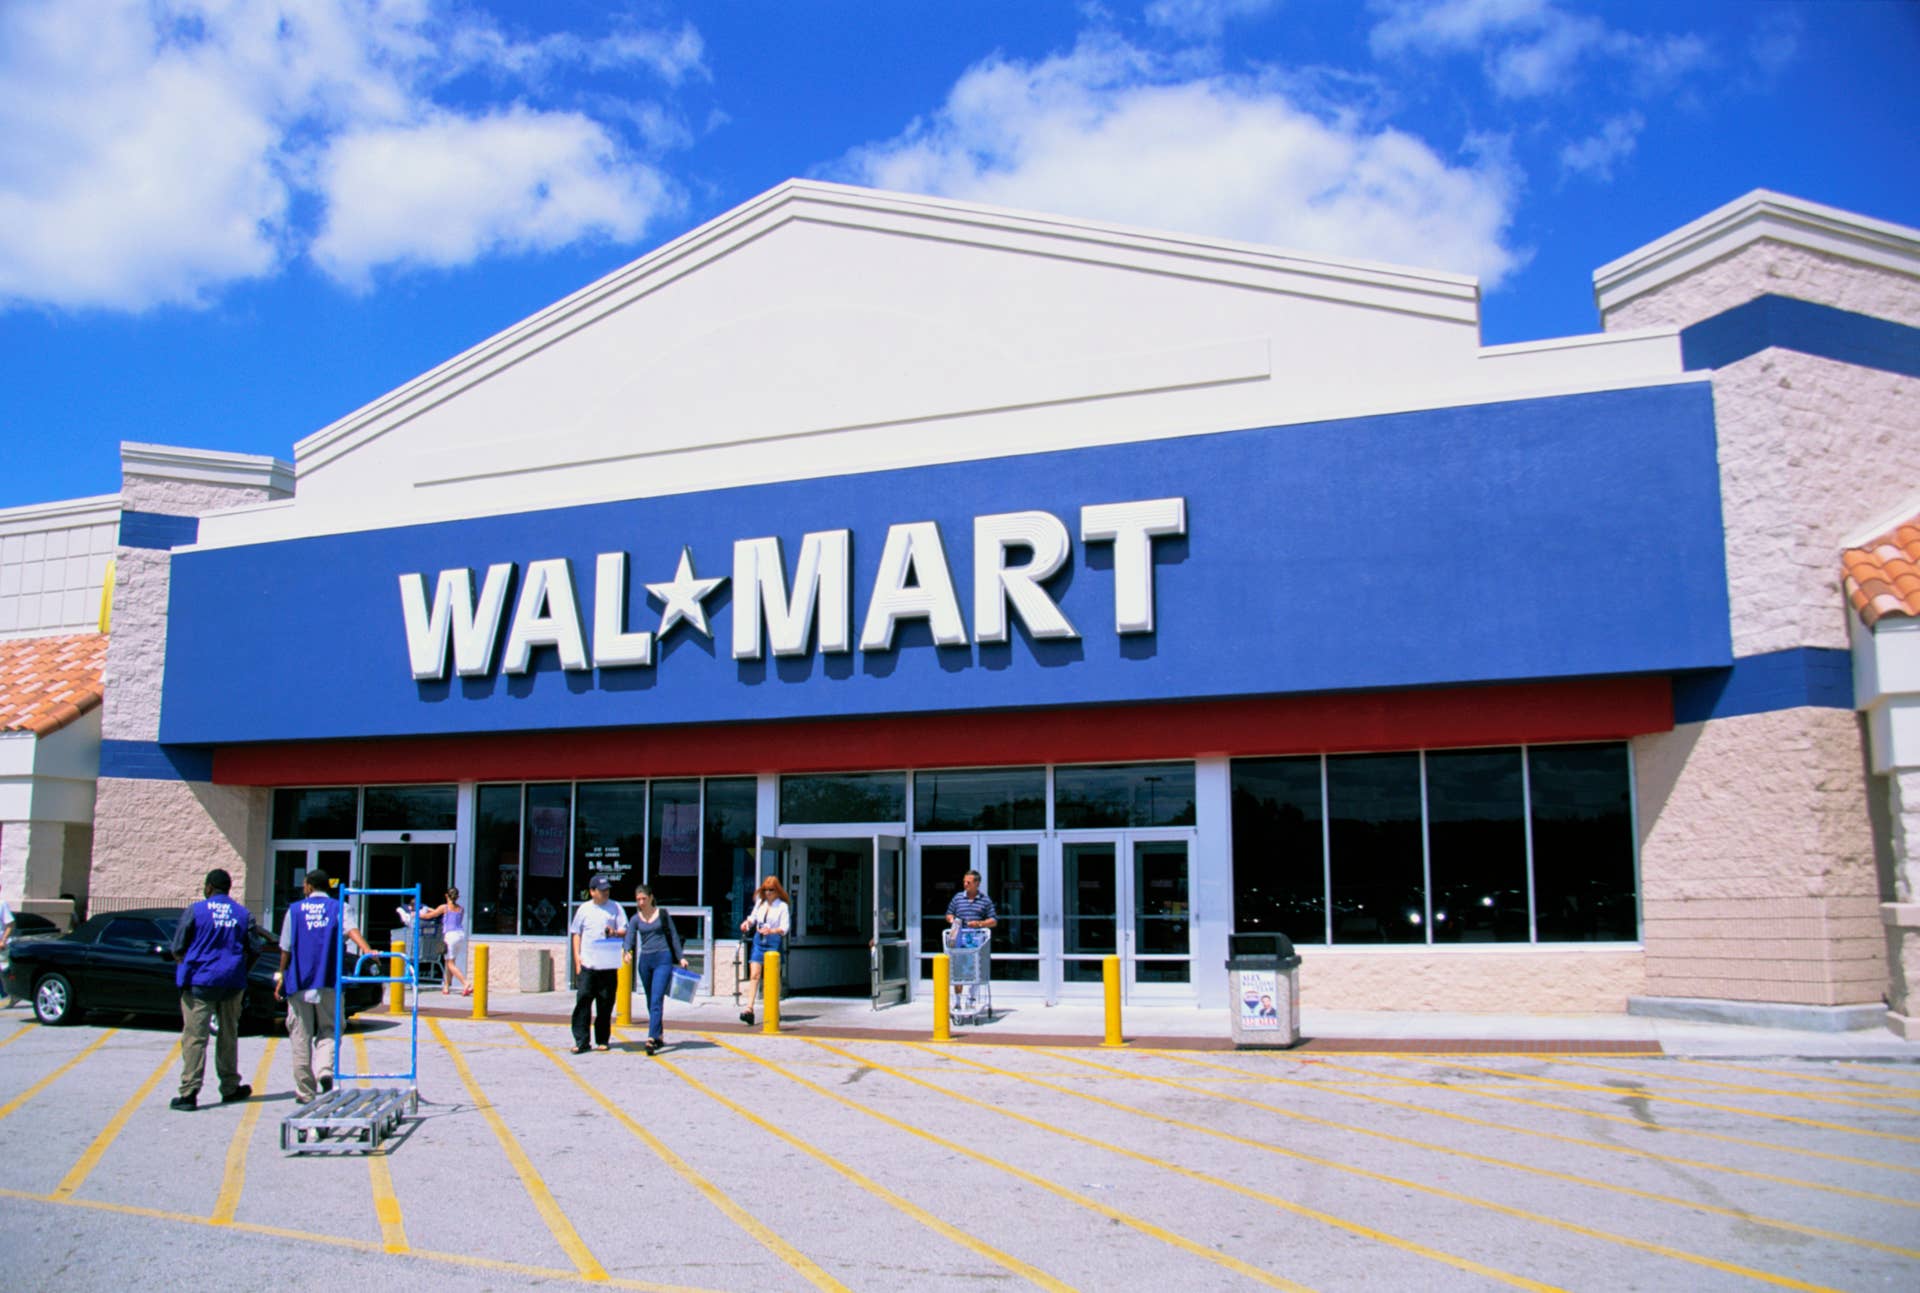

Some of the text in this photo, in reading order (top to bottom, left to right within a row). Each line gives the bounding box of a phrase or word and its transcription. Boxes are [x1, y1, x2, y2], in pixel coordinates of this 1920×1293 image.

[208, 901, 231, 910] How
[301, 902, 325, 911] How
[214, 918, 238, 929] you?
[306, 917, 330, 930] you?
